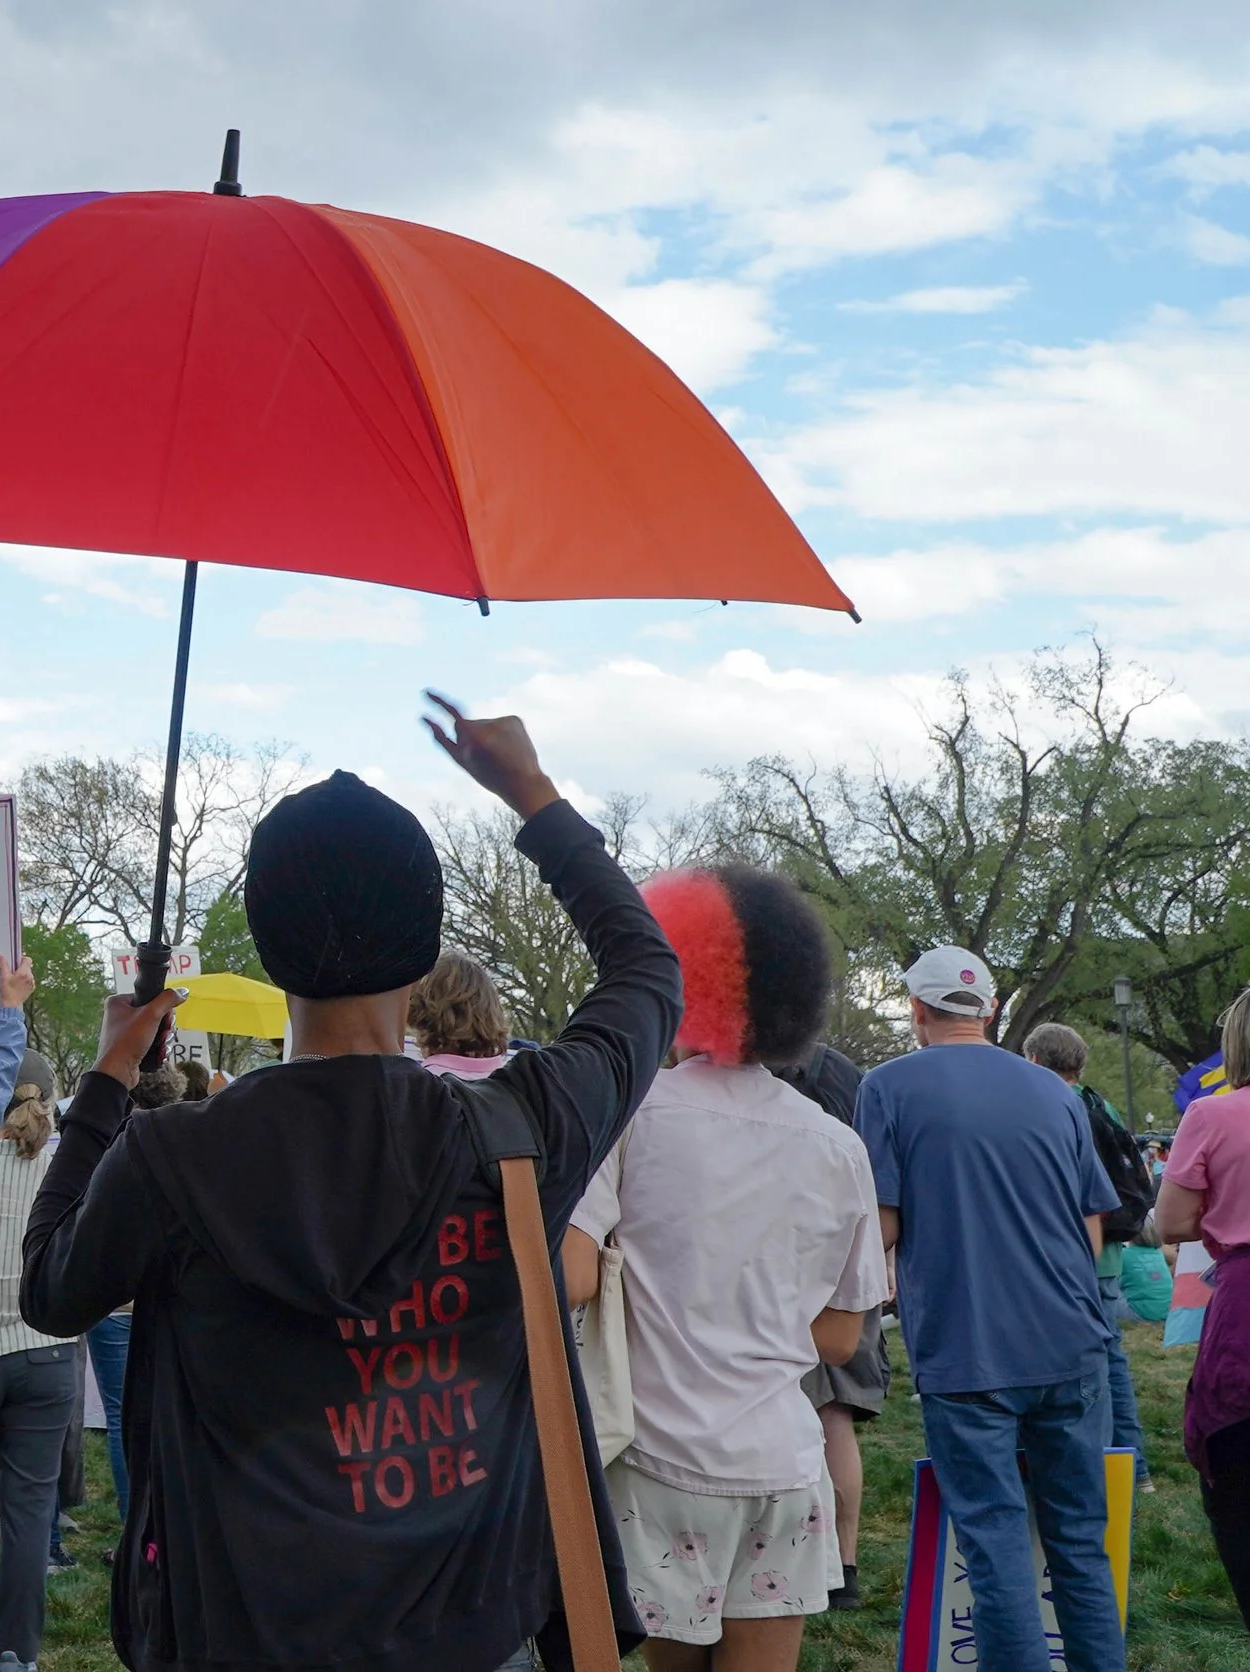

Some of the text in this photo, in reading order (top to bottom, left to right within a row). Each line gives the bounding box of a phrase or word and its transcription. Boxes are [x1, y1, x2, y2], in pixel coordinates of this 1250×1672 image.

[166, 1043, 203, 1064] RE
[437, 1209, 503, 1267] BE
[346, 1331, 461, 1396] YOU
[324, 1378, 481, 1457] WANT
[337, 1443, 488, 1514] TO BE
